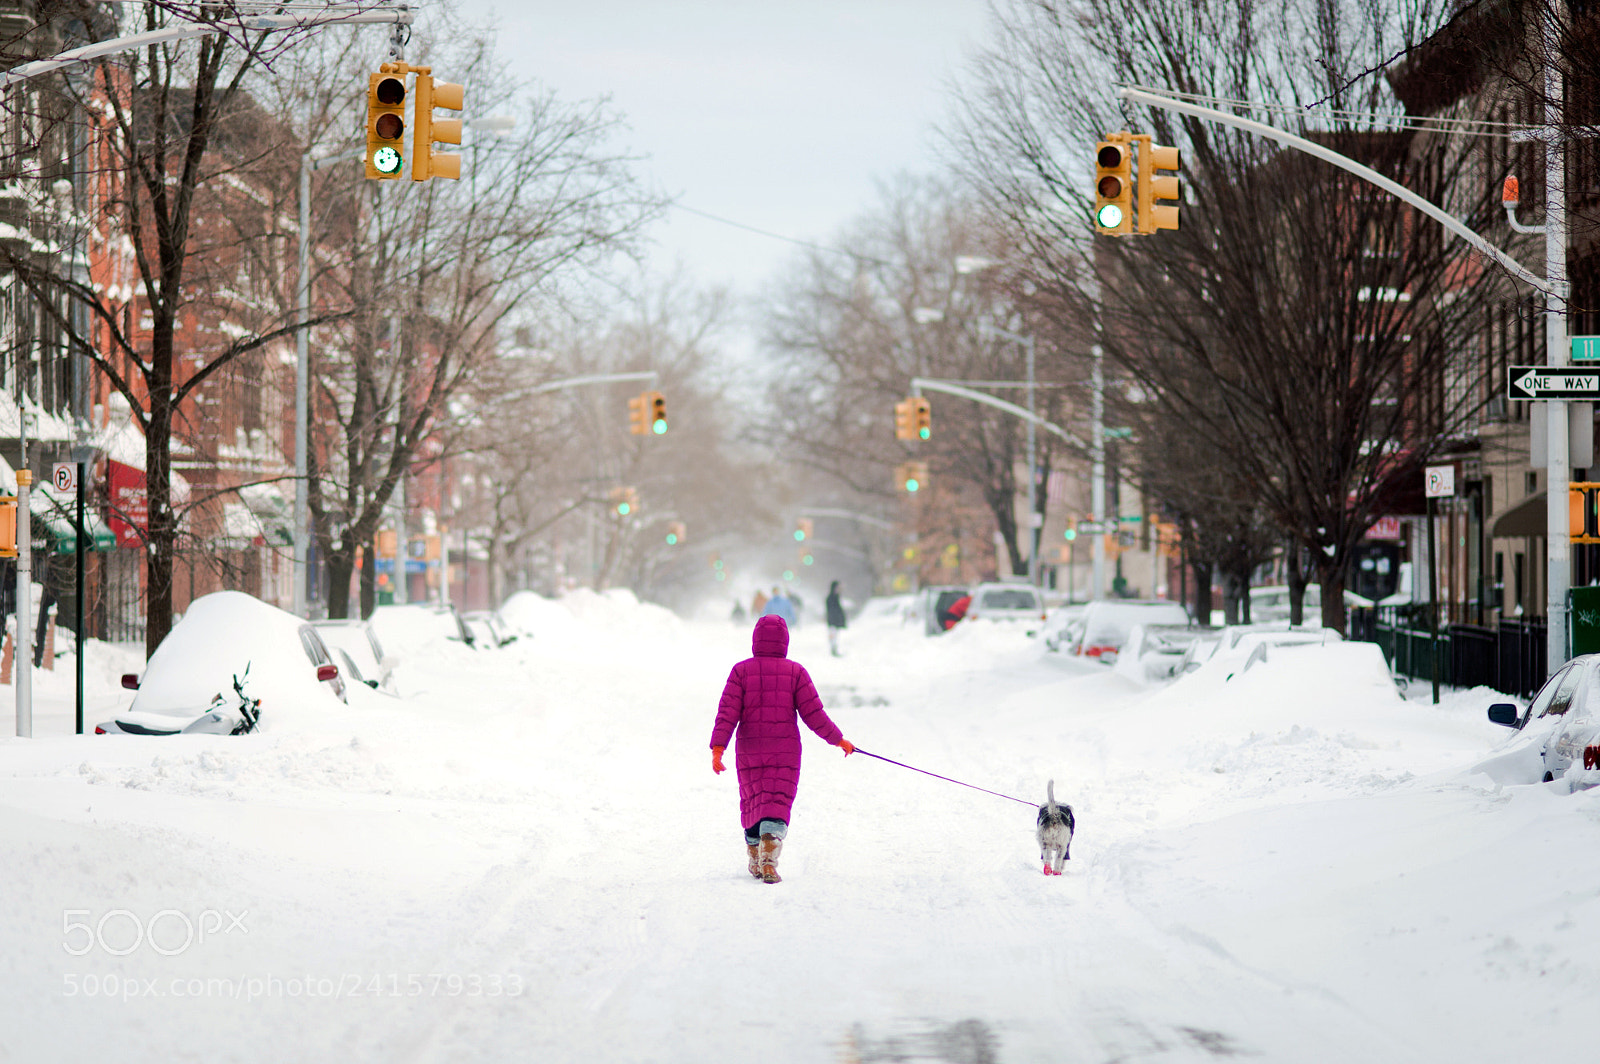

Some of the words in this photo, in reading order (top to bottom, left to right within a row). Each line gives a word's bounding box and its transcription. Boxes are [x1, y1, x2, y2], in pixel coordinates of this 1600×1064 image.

[1583, 340, 1594, 358] 11
[1524, 377, 1551, 389] ONE
[1564, 377, 1593, 389] WAY
